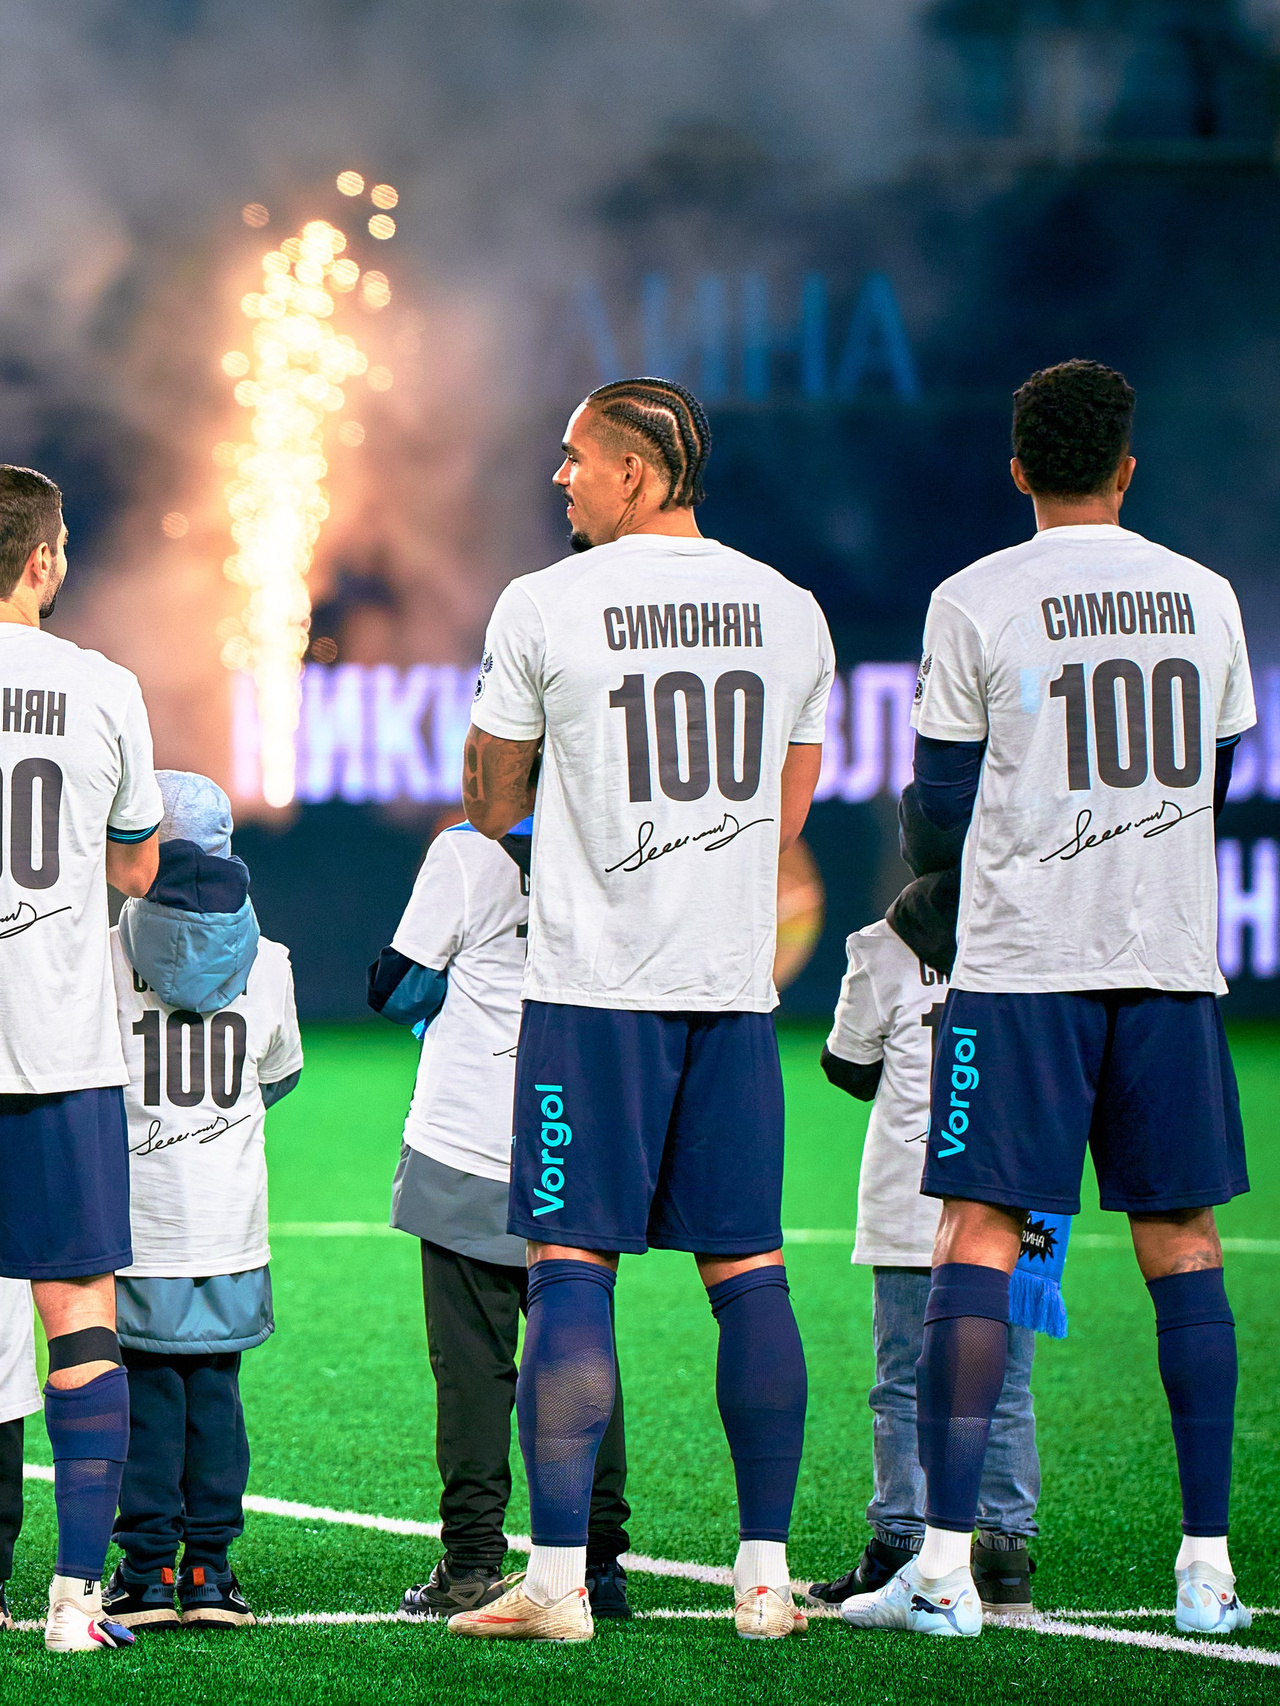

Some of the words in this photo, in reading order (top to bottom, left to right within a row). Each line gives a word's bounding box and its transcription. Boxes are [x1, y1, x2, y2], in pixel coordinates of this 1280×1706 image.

[603, 602, 763, 651] СИМОНЯН
[1041, 591, 1196, 641] СИМОНЯН
[608, 669, 765, 803] 100
[1049, 657, 1202, 791] 100
[132, 1009, 247, 1109] 100
[937, 1026, 980, 1159] Vorgol
[532, 1084, 573, 1217] Vorgol
